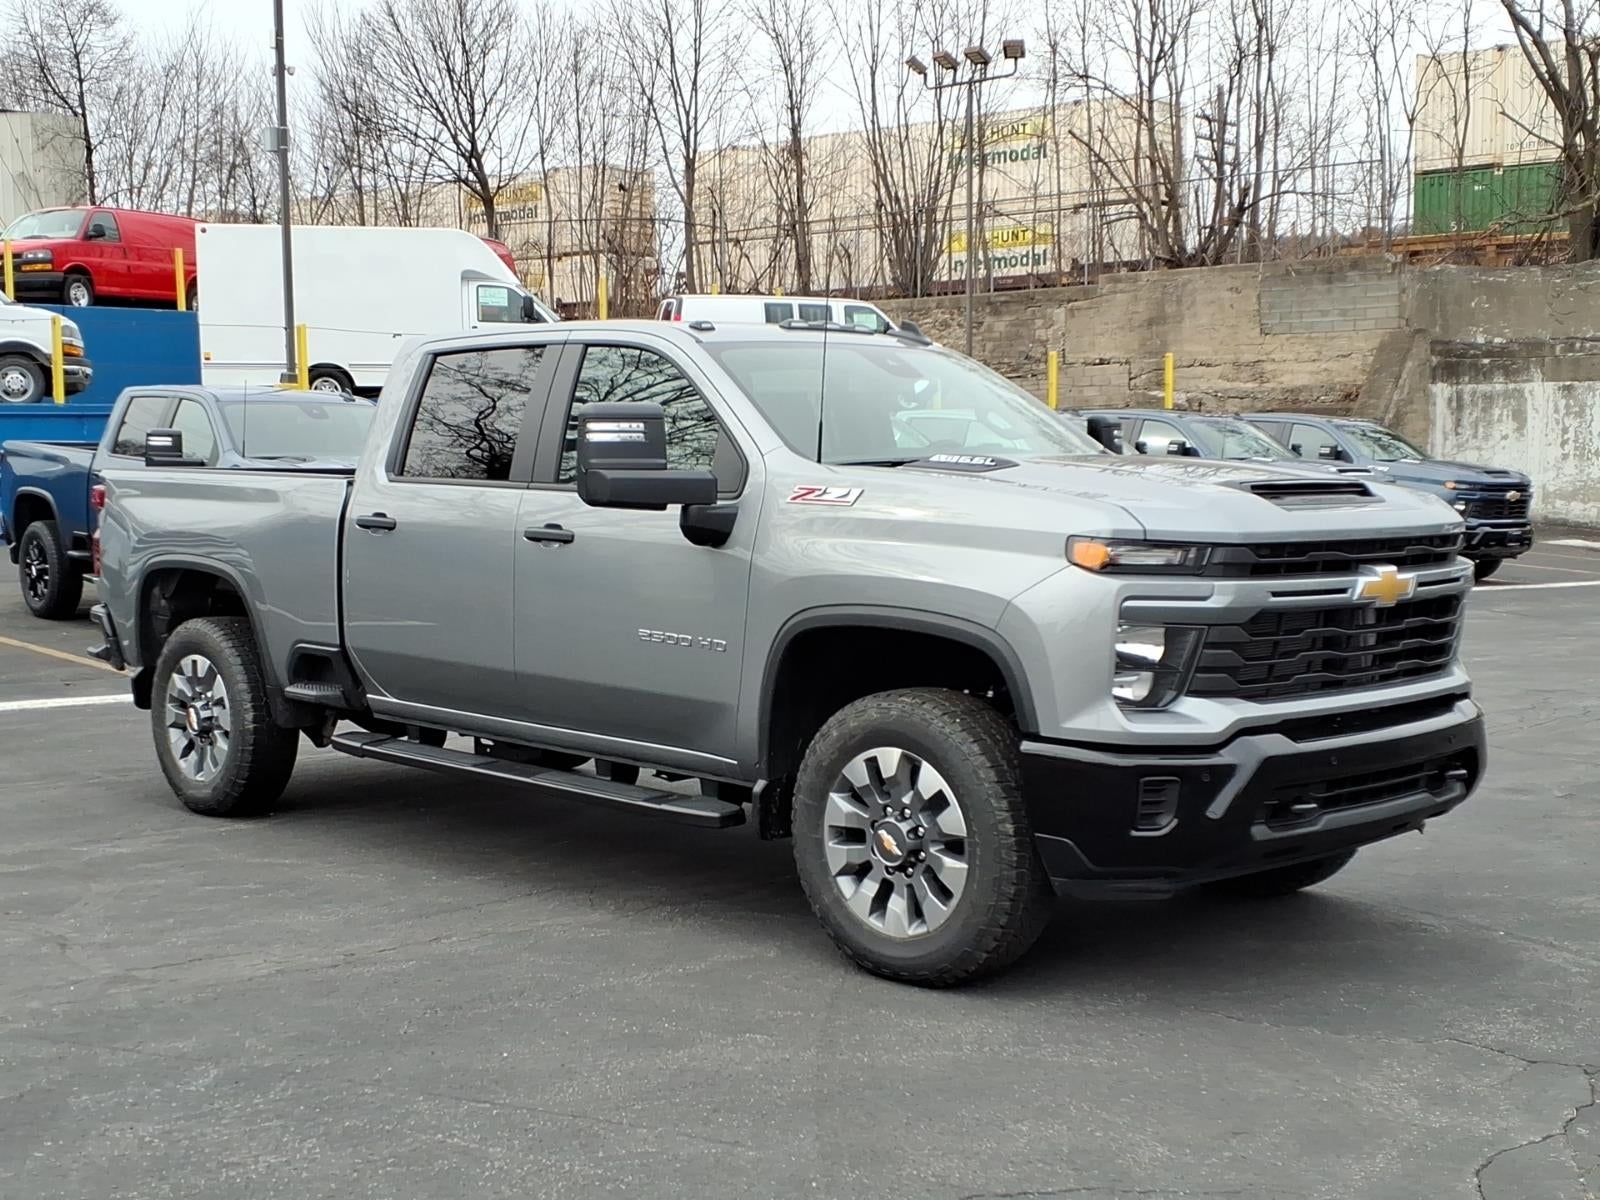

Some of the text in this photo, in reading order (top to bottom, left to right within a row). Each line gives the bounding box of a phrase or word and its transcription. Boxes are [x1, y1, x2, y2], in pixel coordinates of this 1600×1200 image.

[991, 122, 1028, 138] HUNT
[468, 204, 538, 224] ntrmodal
[992, 229, 1028, 243] HUNT
[786, 485, 864, 506] Z71
[638, 628, 727, 652] 2500 HD
